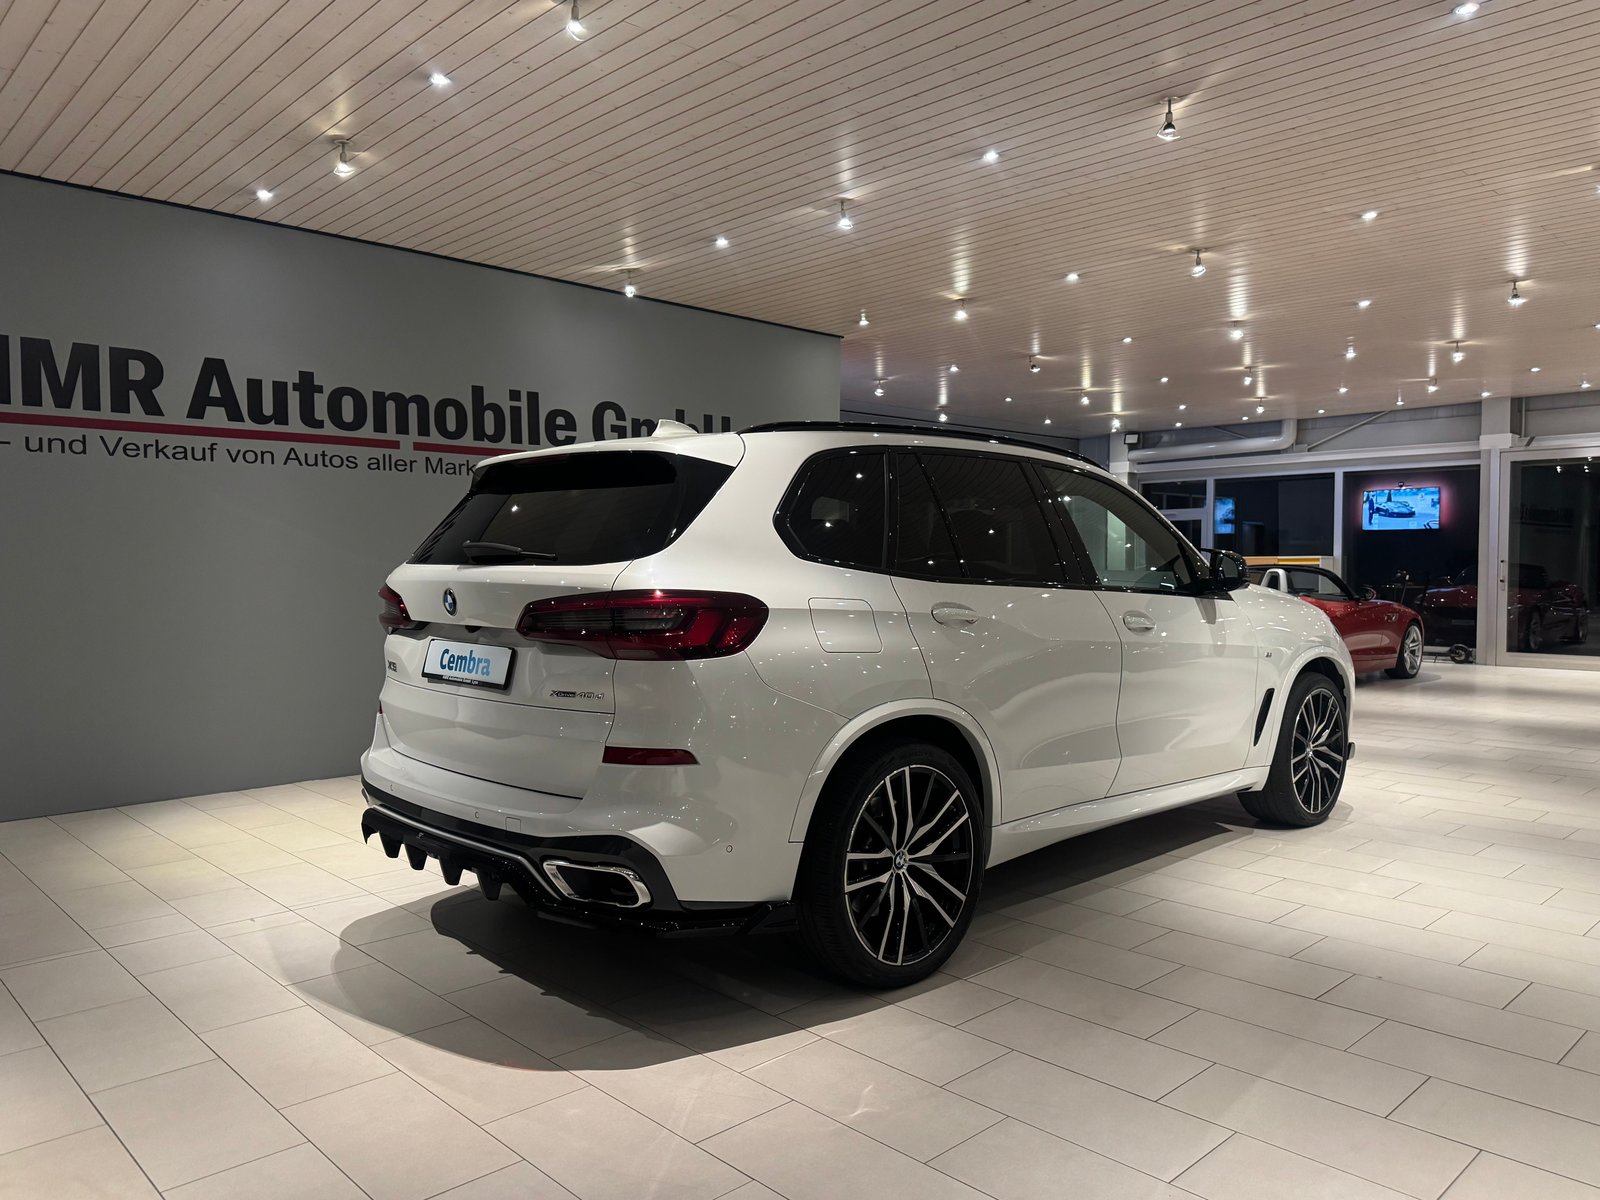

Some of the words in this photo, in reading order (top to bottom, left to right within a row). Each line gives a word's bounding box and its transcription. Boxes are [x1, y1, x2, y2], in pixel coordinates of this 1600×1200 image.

[0, 334, 165, 416] MR
[186, 357, 577, 446] Automobile
[24, 434, 87, 455] und
[99, 435, 218, 463] Verkauf
[226, 447, 275, 465] von
[283, 447, 358, 470] Autos
[367, 453, 418, 472] aller
[440, 648, 491, 676] Cembra
